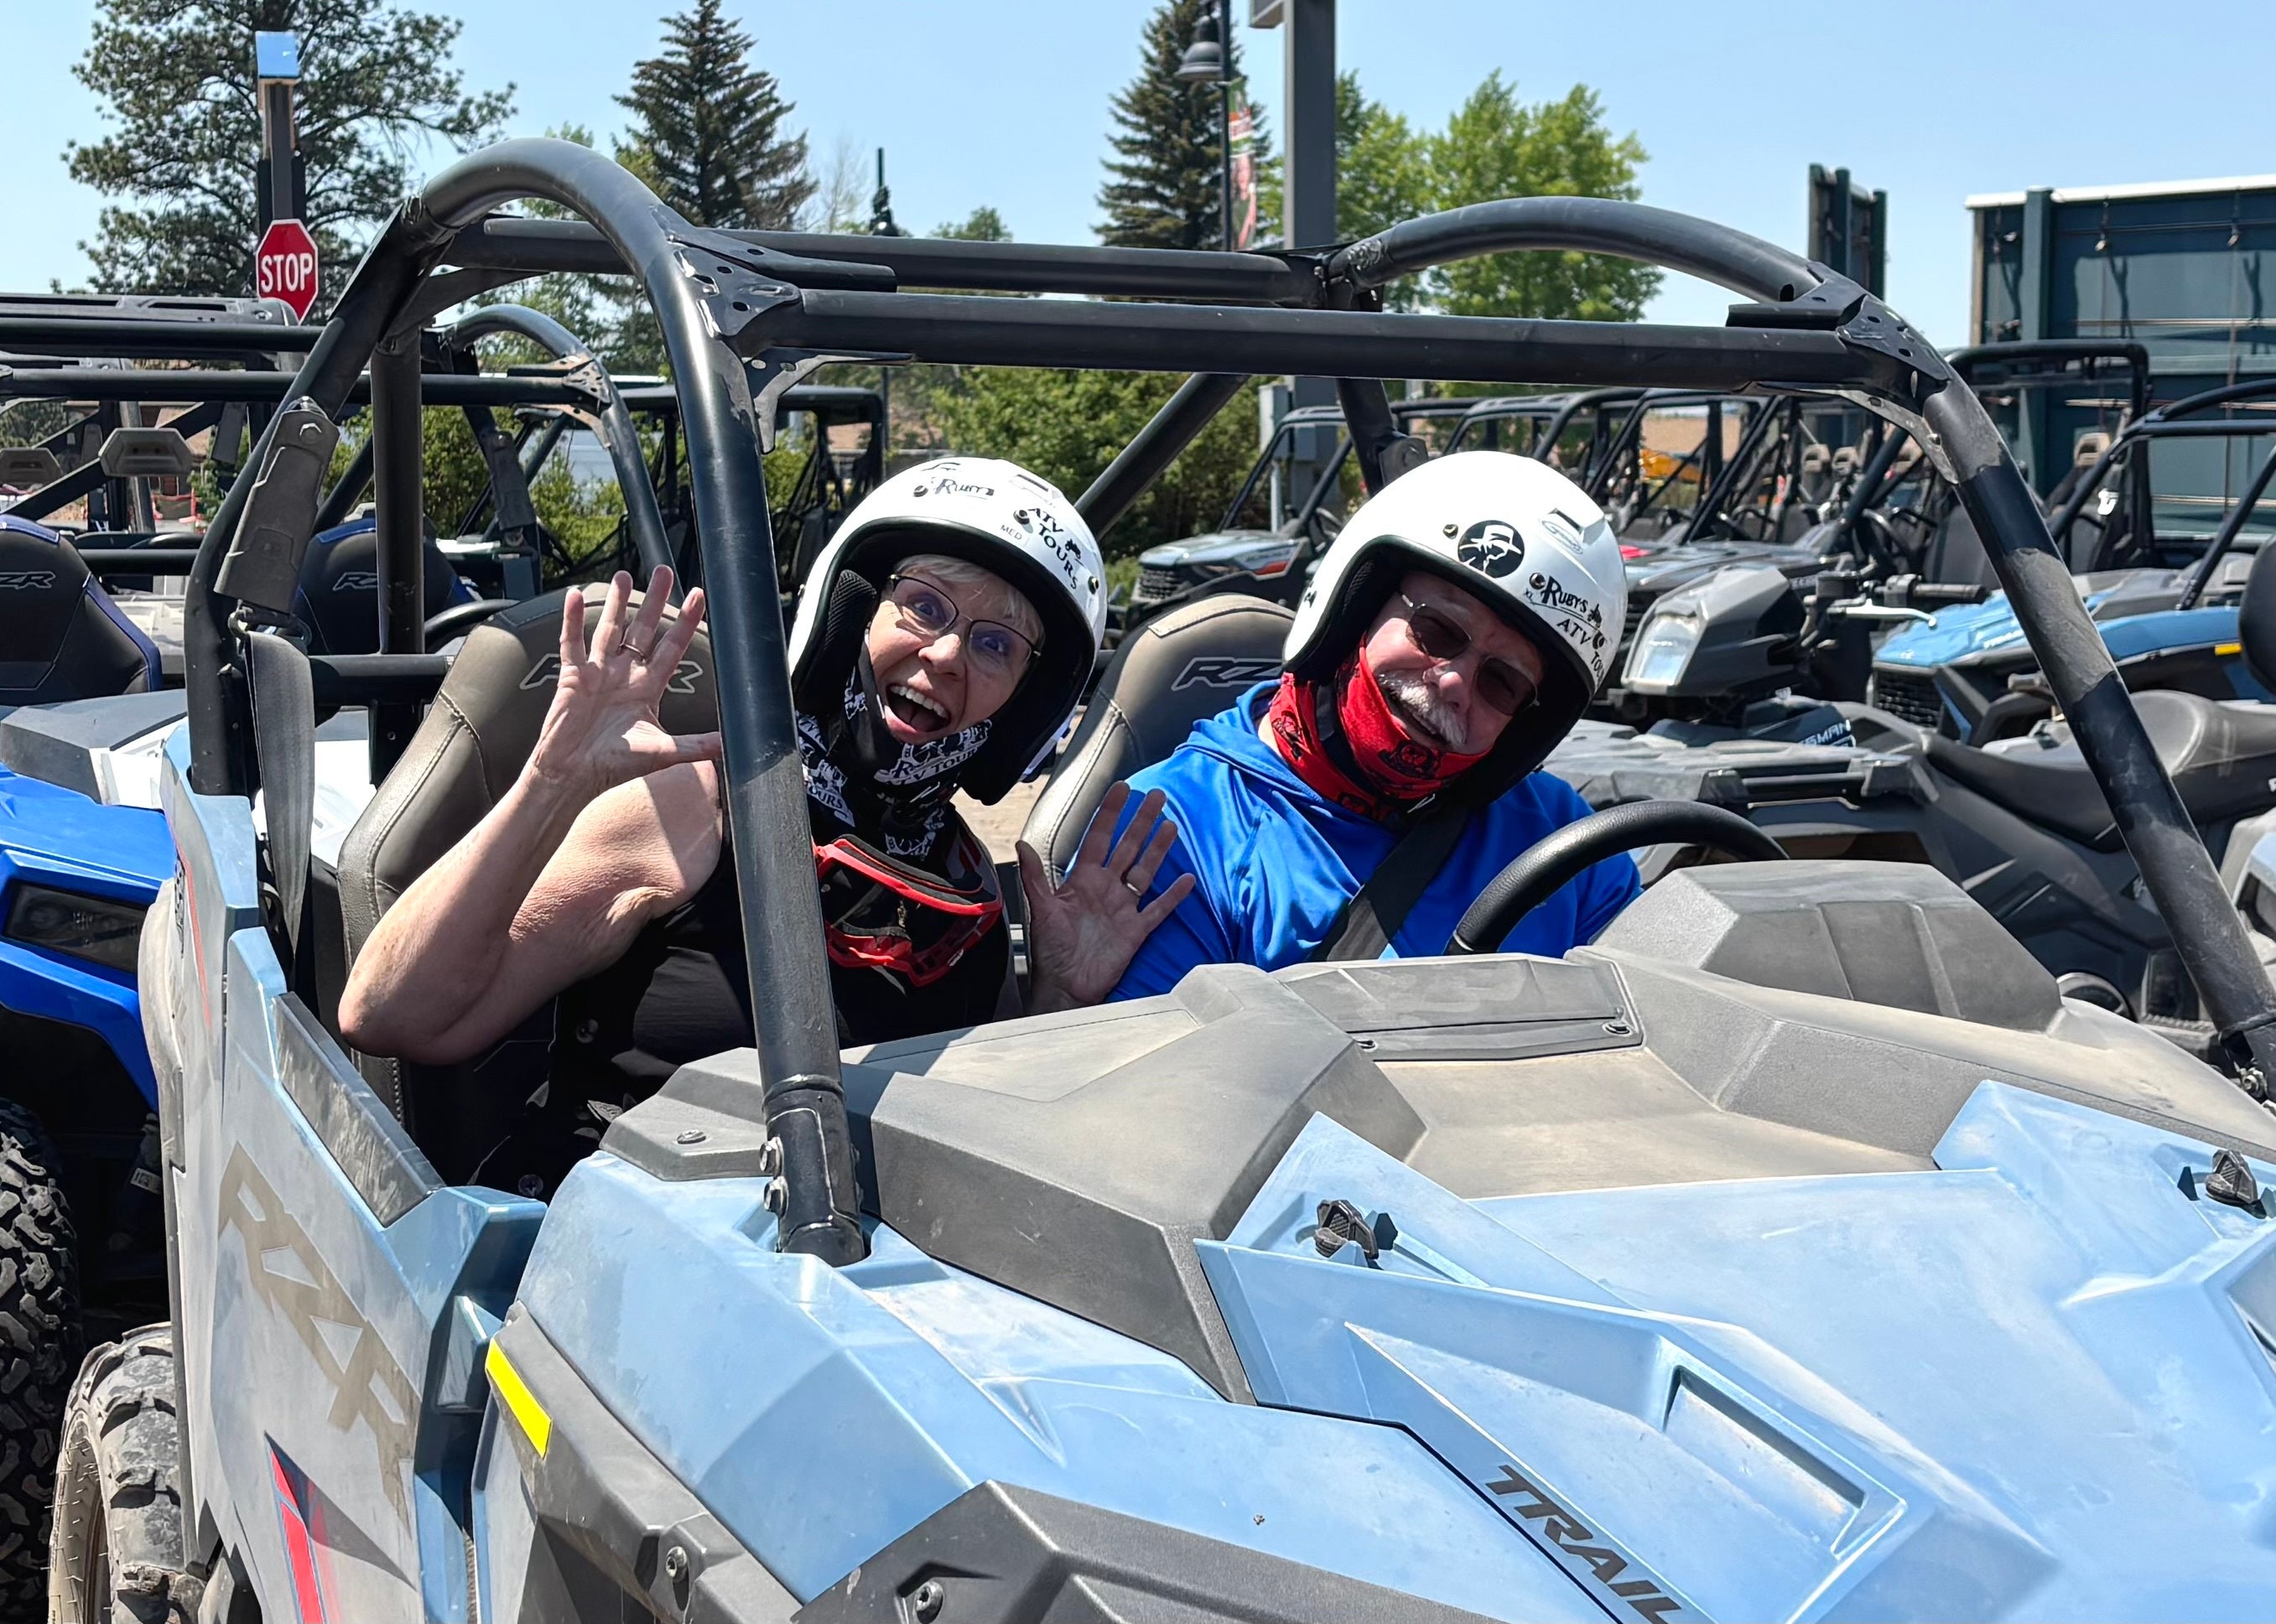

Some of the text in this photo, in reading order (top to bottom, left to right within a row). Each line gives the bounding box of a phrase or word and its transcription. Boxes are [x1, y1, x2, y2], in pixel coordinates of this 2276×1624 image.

[261, 252, 313, 293] STOP
[1000, 524, 1023, 540] MED
[1027, 507, 1078, 590] ATV TOURS
[0, 571, 56, 589] ZR
[1556, 618, 1592, 645] ATV
[1171, 656, 1283, 692] RZ
[808, 785, 844, 811] OURS
[1485, 1464, 1682, 1624] TRAIL
